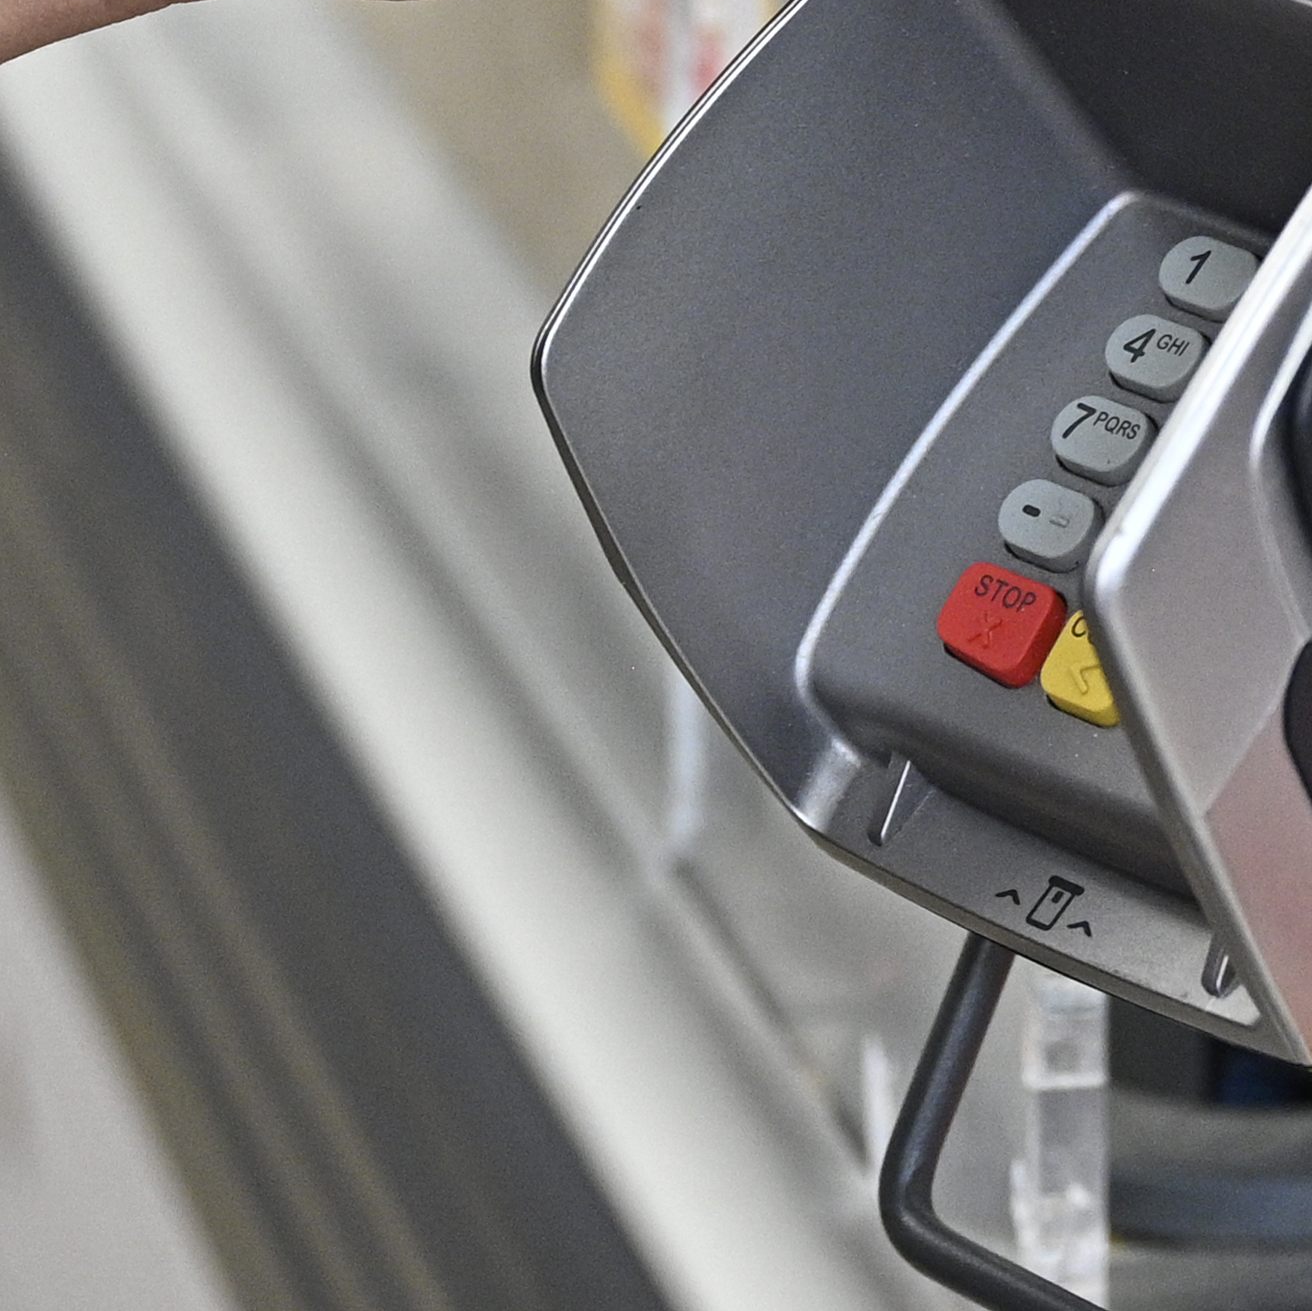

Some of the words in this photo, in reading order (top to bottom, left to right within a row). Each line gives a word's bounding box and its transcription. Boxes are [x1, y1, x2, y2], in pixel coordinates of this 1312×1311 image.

[1185, 250, 1212, 285] 1
[1123, 328, 1156, 363] 4
[1156, 334, 1190, 357] GHI
[1062, 402, 1097, 439] 7
[1093, 411, 1141, 440] PQRS
[974, 574, 1037, 613] STOP
